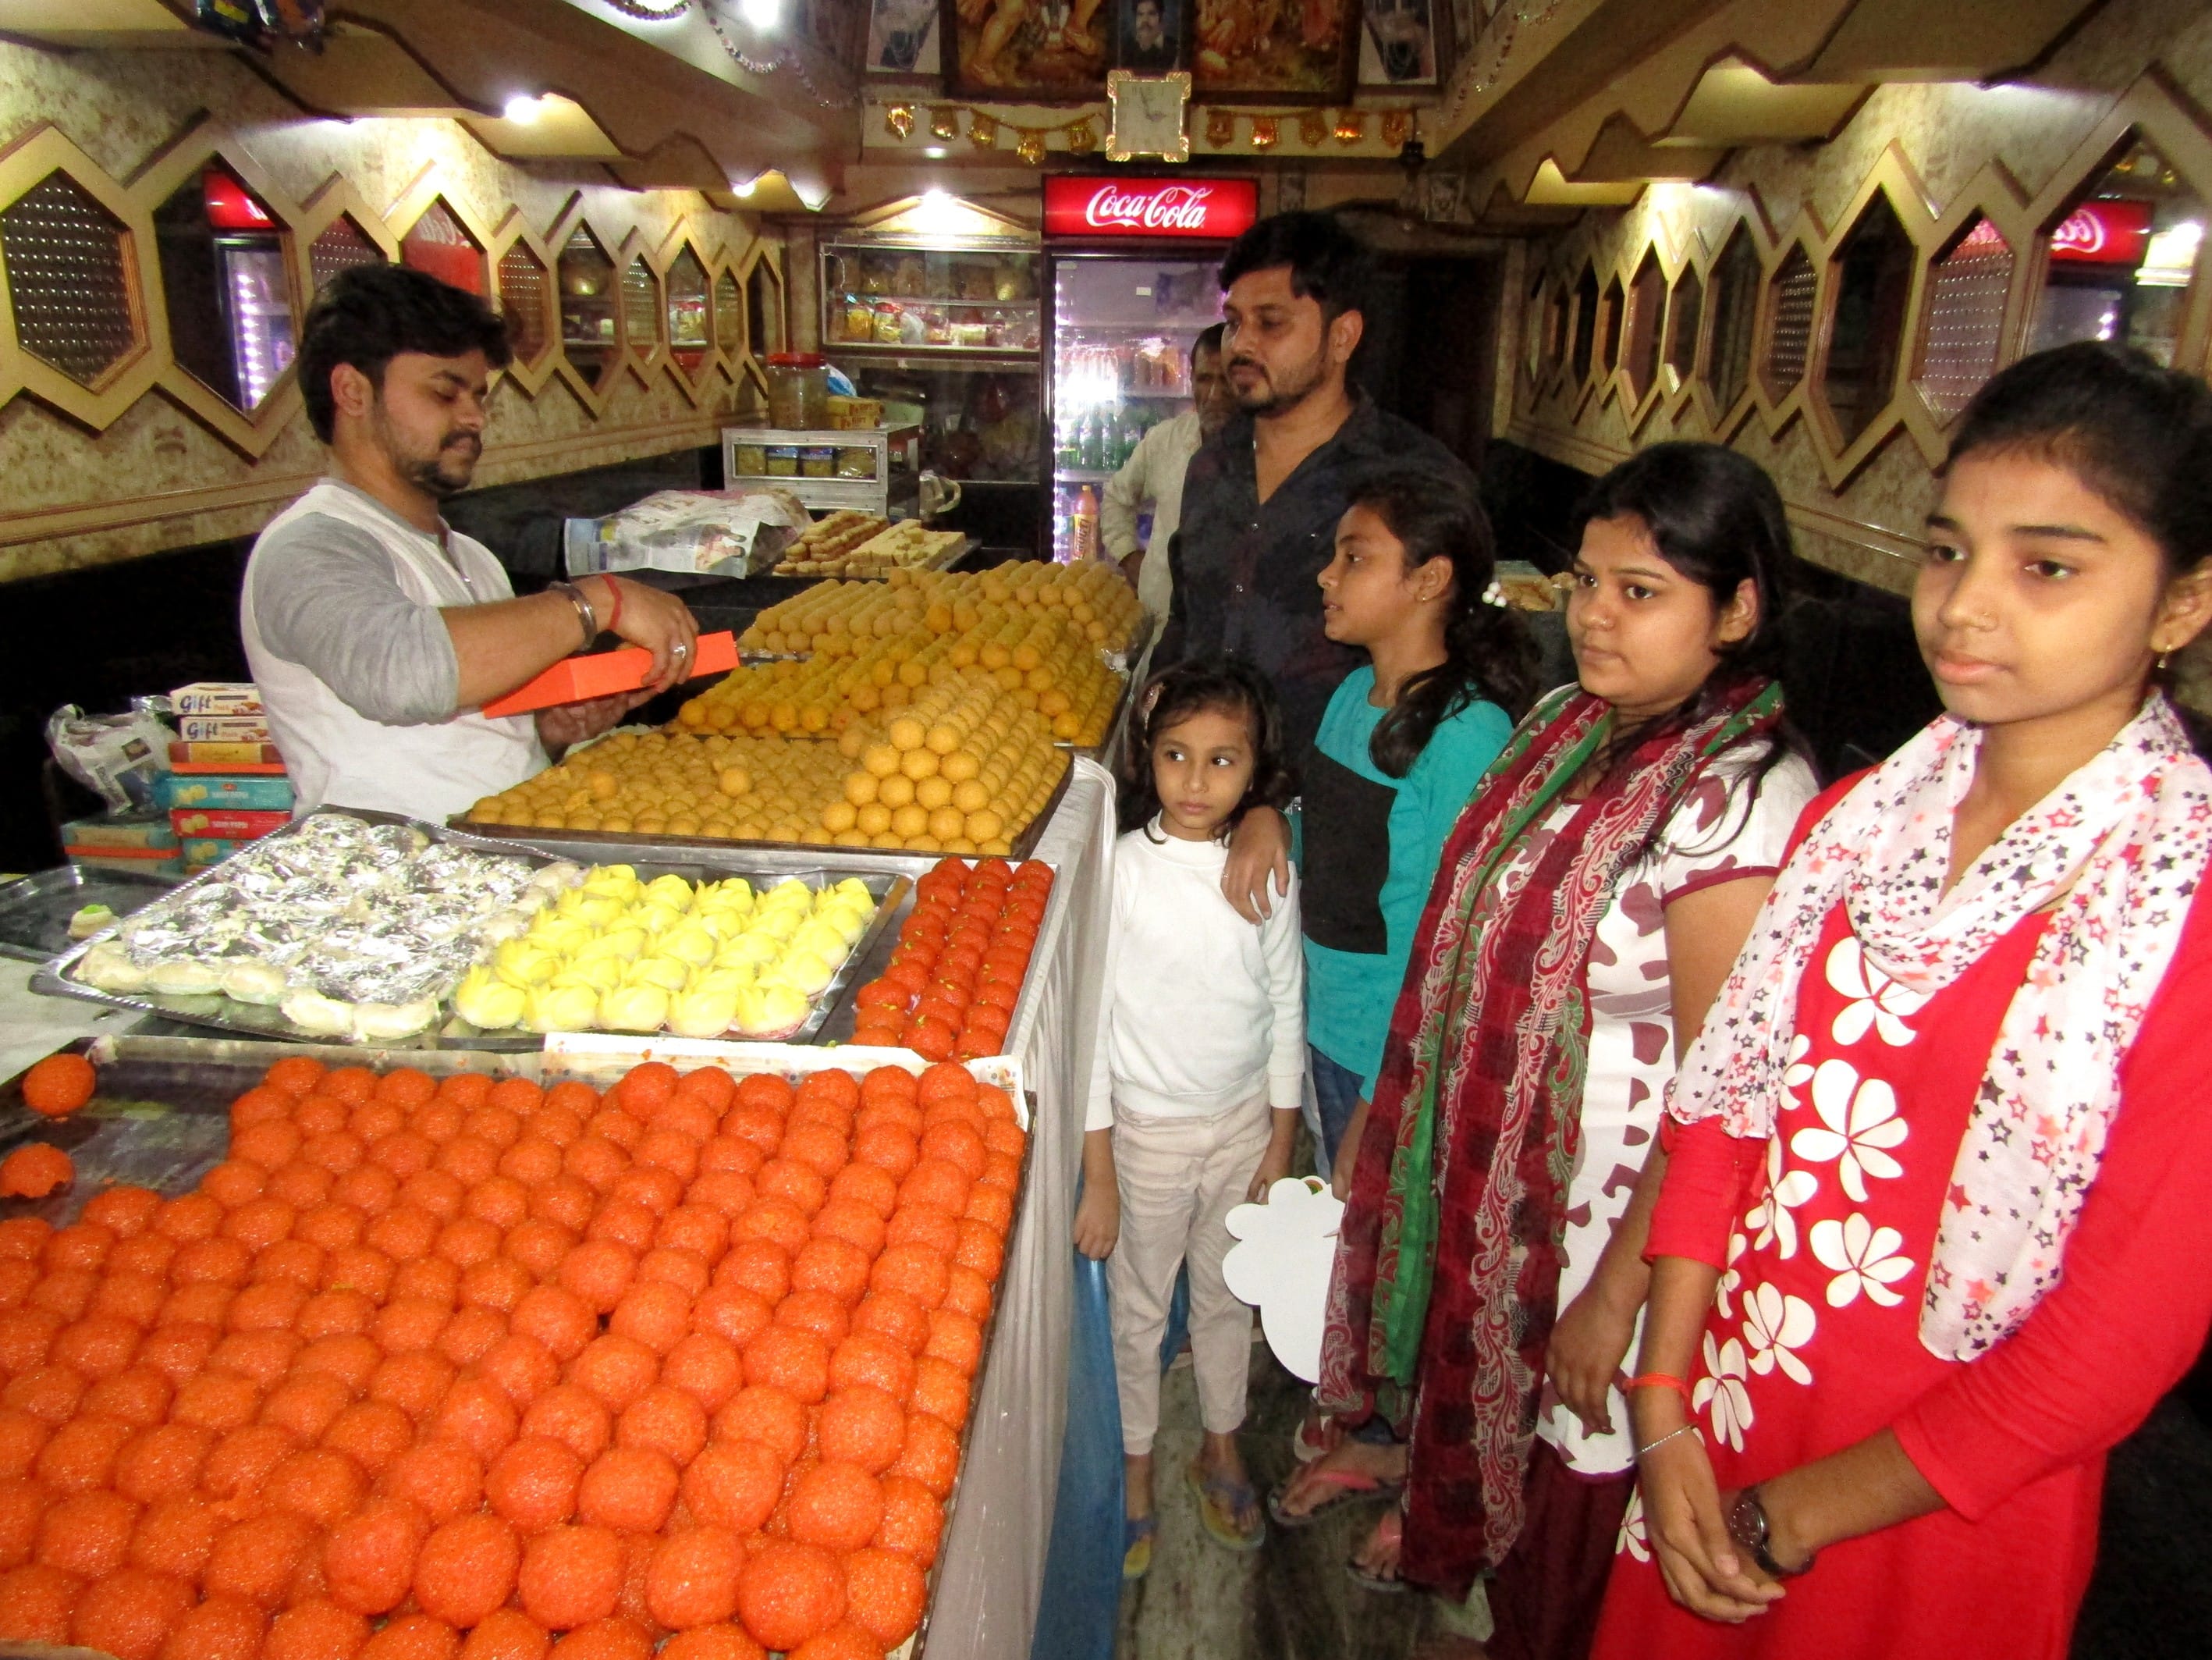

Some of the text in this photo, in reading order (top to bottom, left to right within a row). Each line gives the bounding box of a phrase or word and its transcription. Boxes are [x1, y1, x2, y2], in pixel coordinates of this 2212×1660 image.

[1086, 186, 1213, 229] Coca-Cola
[179, 695, 211, 713] Gift
[187, 722, 218, 739] Gift
